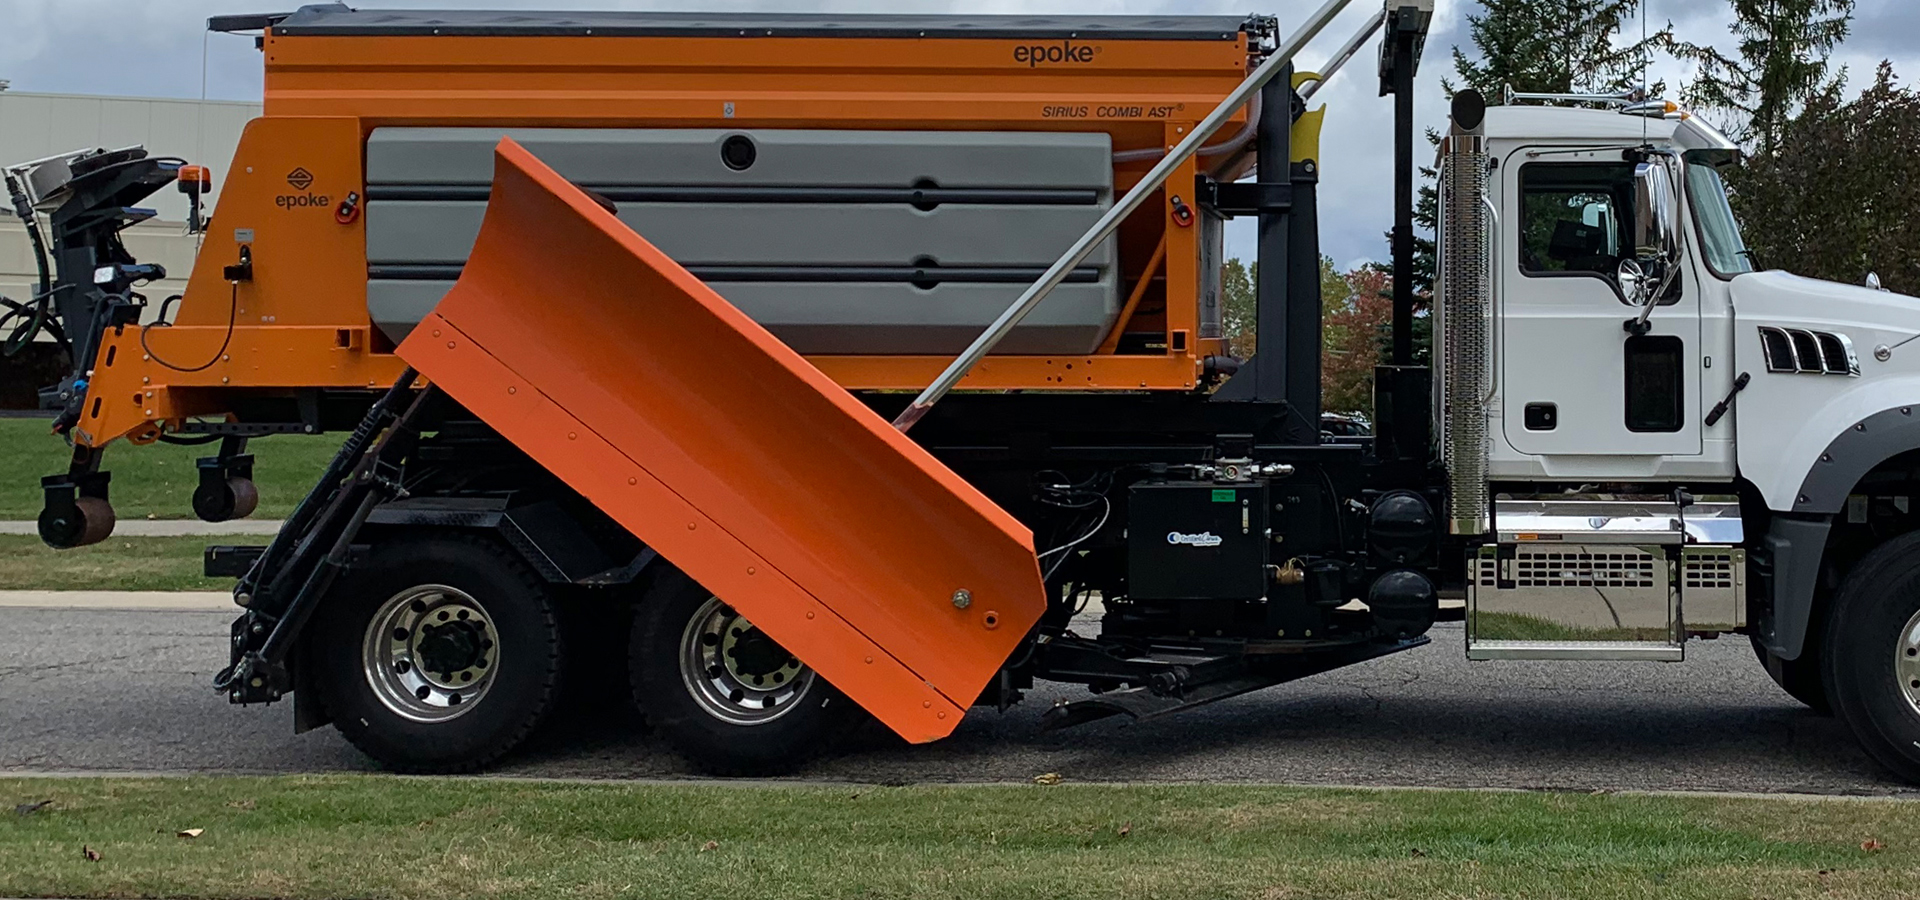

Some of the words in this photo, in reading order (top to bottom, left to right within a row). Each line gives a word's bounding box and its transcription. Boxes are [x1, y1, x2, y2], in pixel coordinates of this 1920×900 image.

[1013, 40, 1094, 68] epoke
[1041, 105, 1089, 118] SIRIUS
[1096, 105, 1143, 118] COMBI
[275, 192, 329, 211] epoke
